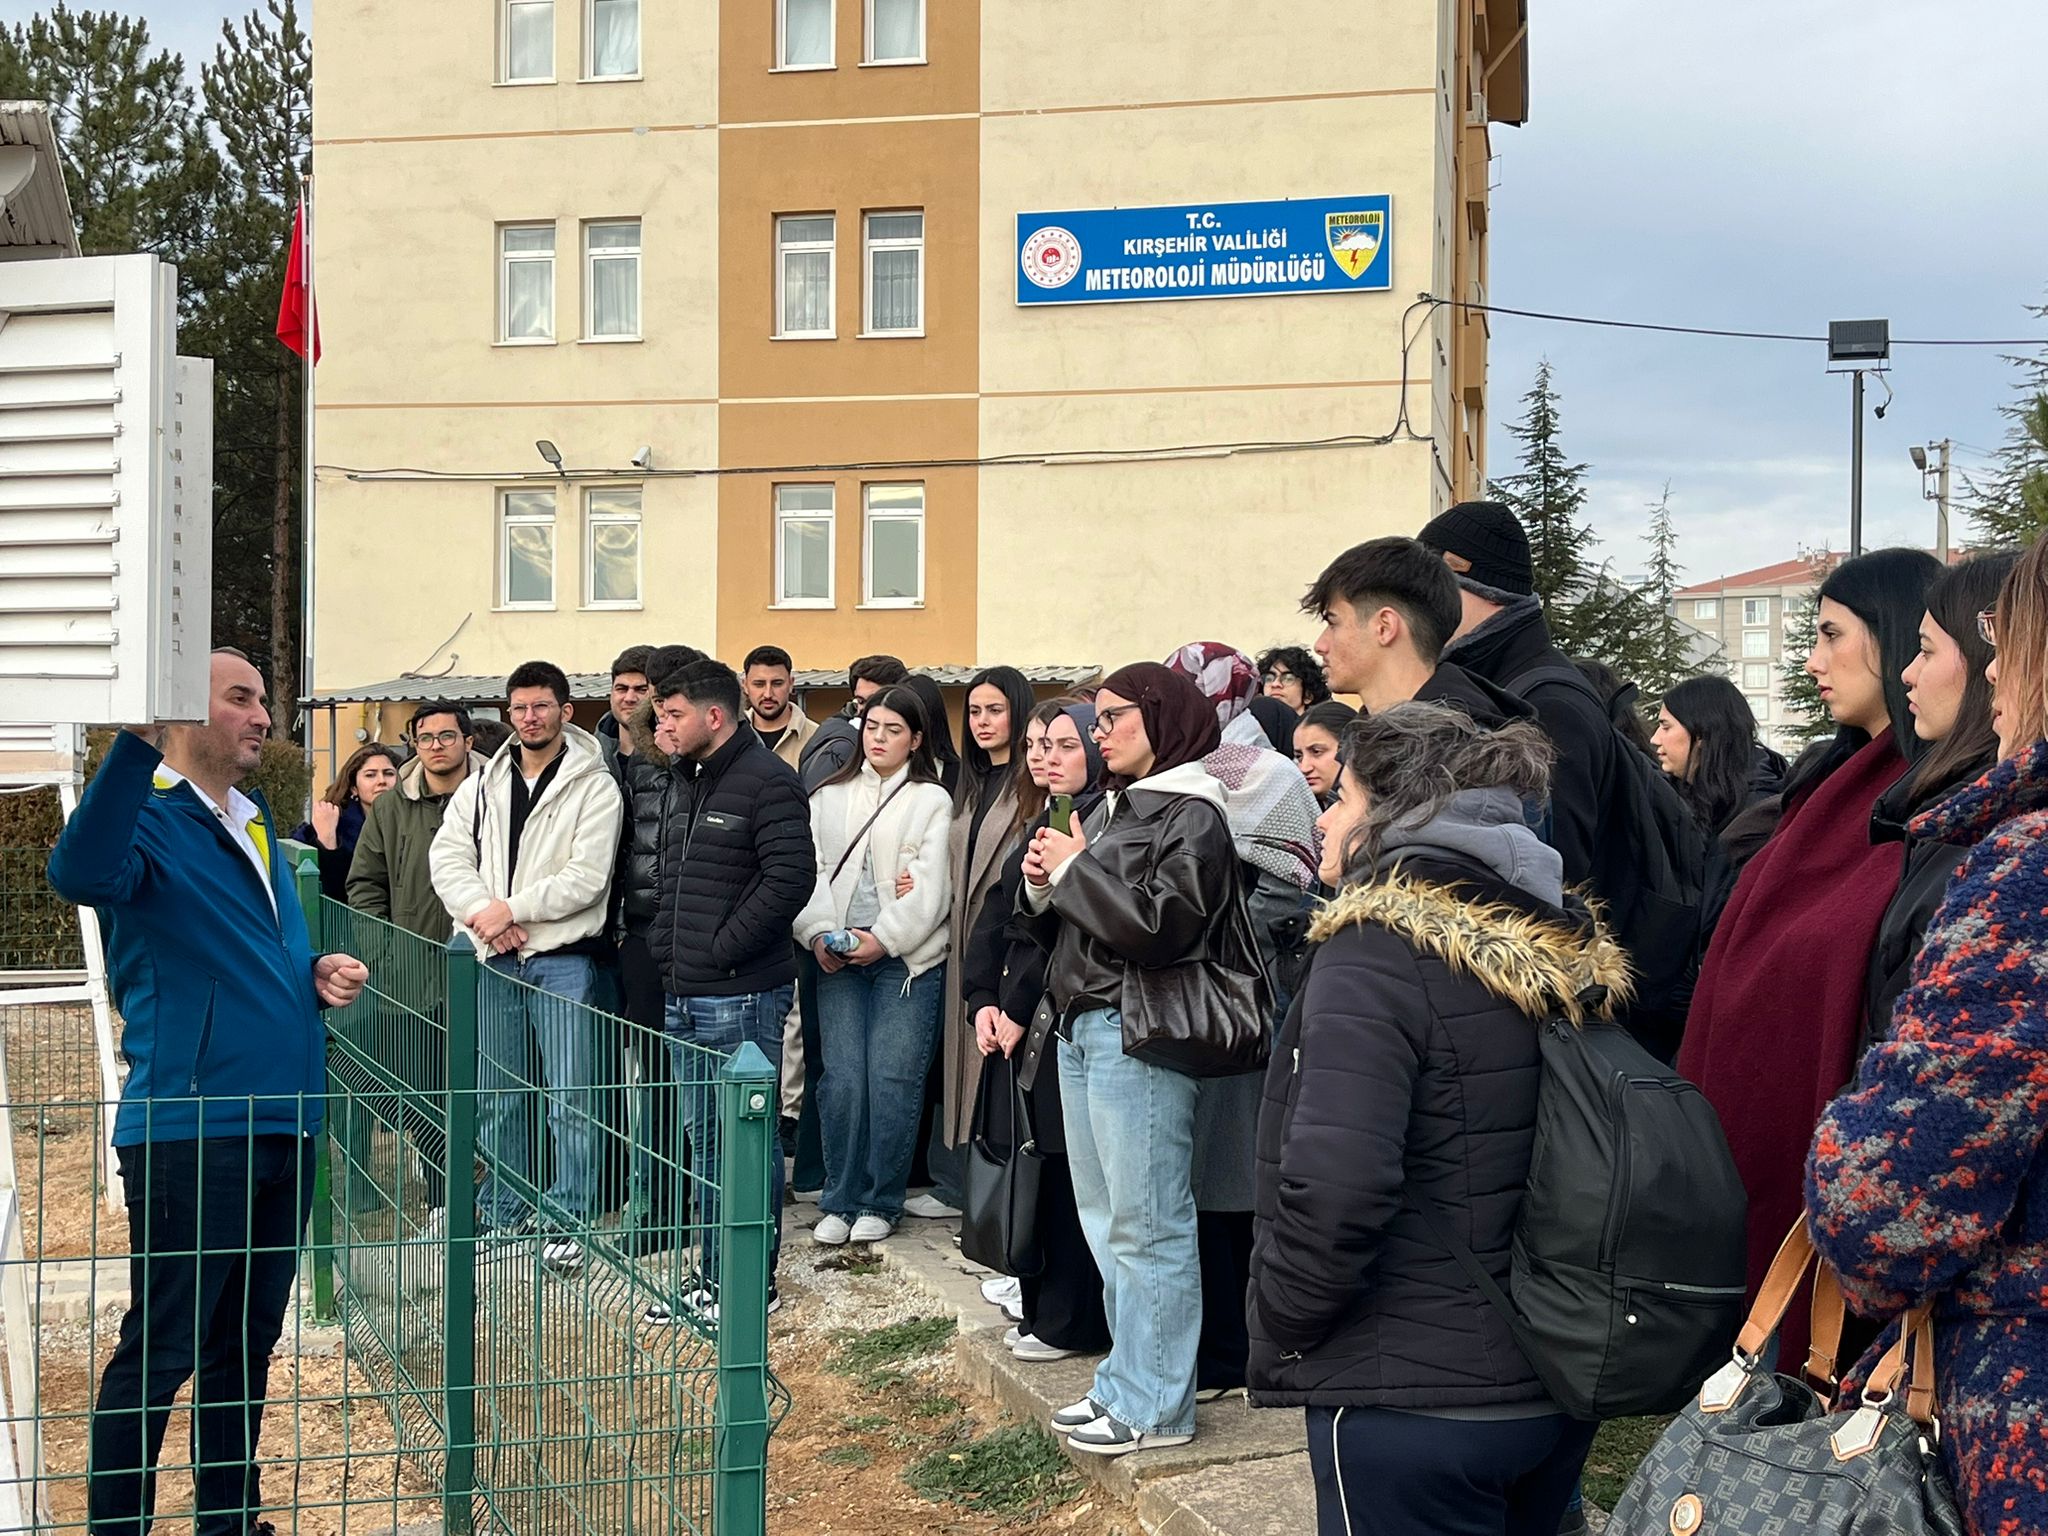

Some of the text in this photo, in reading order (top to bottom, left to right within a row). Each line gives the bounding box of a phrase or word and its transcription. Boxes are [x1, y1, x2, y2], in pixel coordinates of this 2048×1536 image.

[1186, 212, 1222, 229] T.C.
[1124, 228, 1287, 258] KIRŞEHİR VALİLİĞİ
[1085, 252, 1325, 291] METEOROLOJİ MÜDÜRLÜĞÜ
